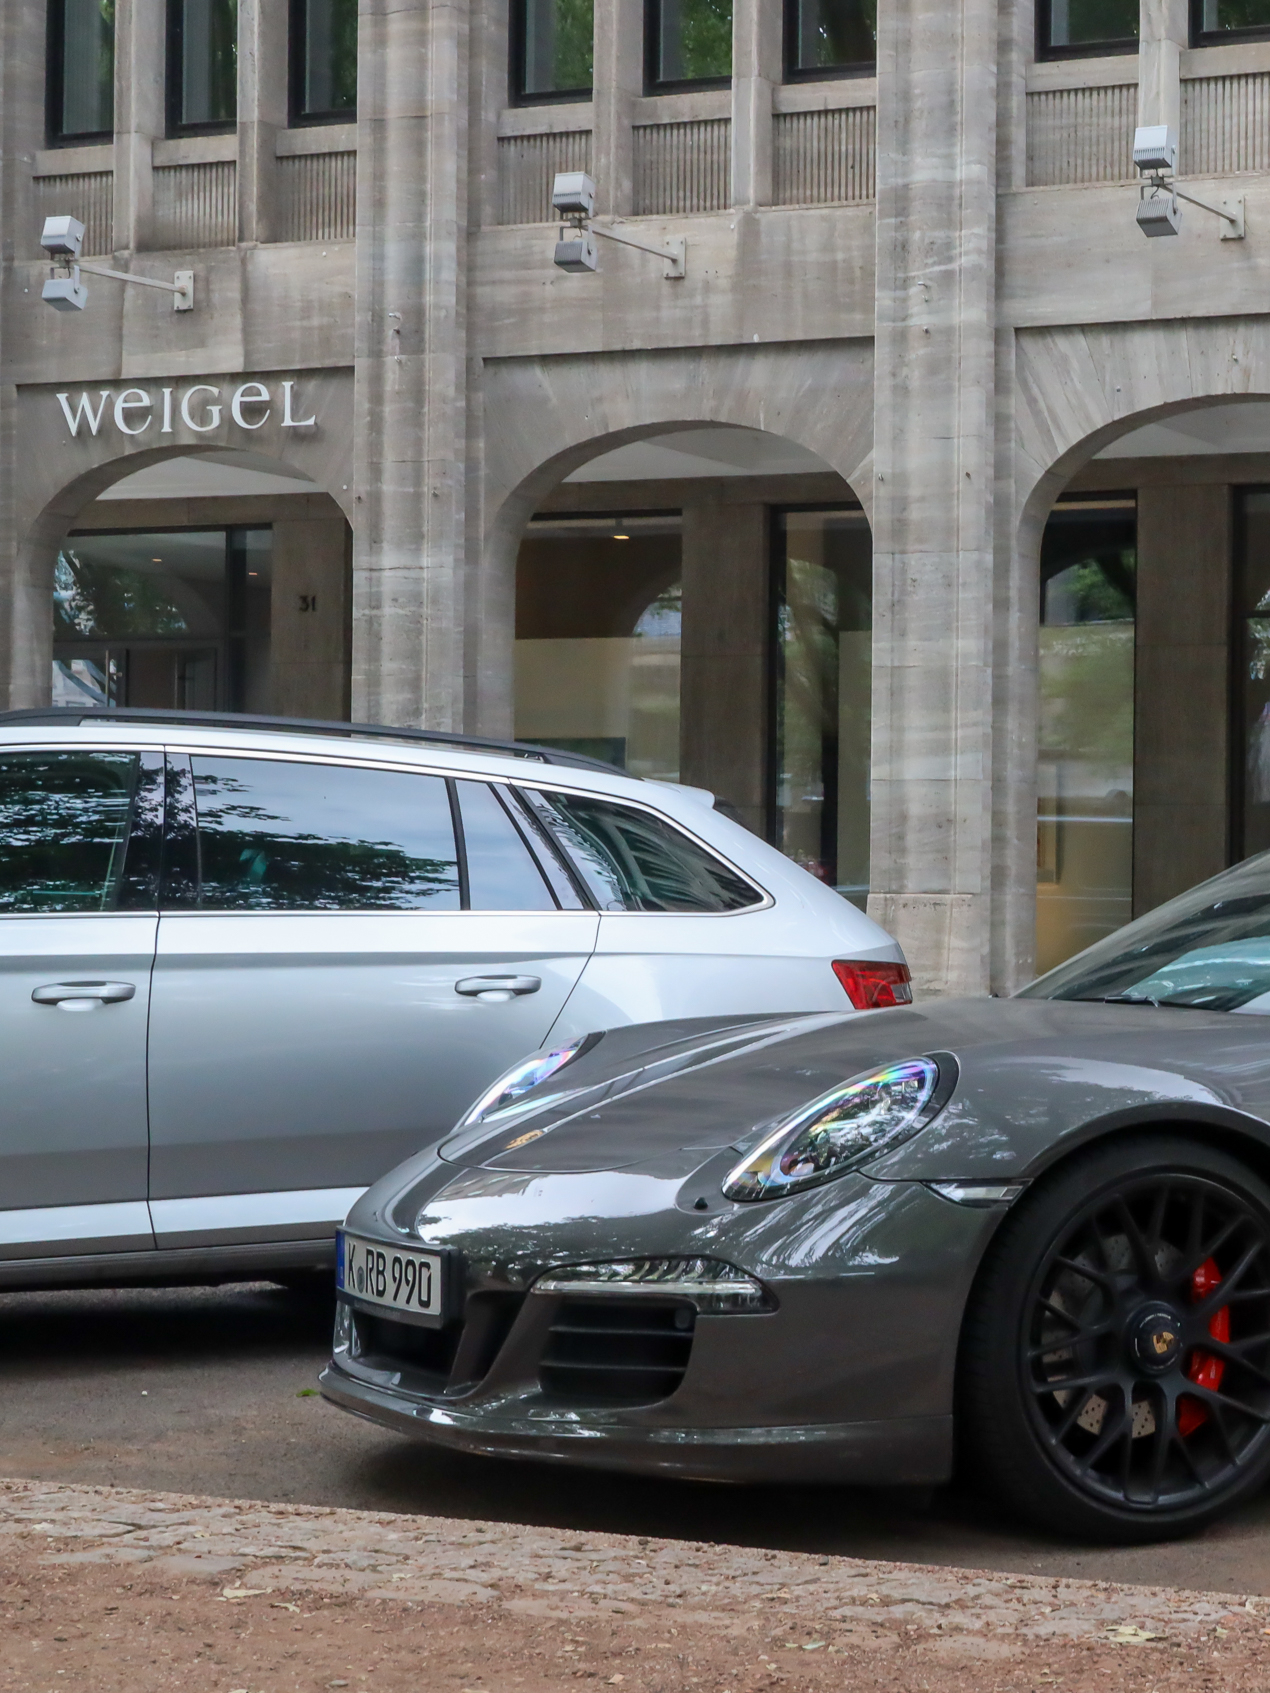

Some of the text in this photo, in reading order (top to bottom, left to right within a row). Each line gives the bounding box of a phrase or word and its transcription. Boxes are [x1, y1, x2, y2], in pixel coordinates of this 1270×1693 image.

[299, 594, 317, 612] 31
[348, 1241, 432, 1309] K RB 990
